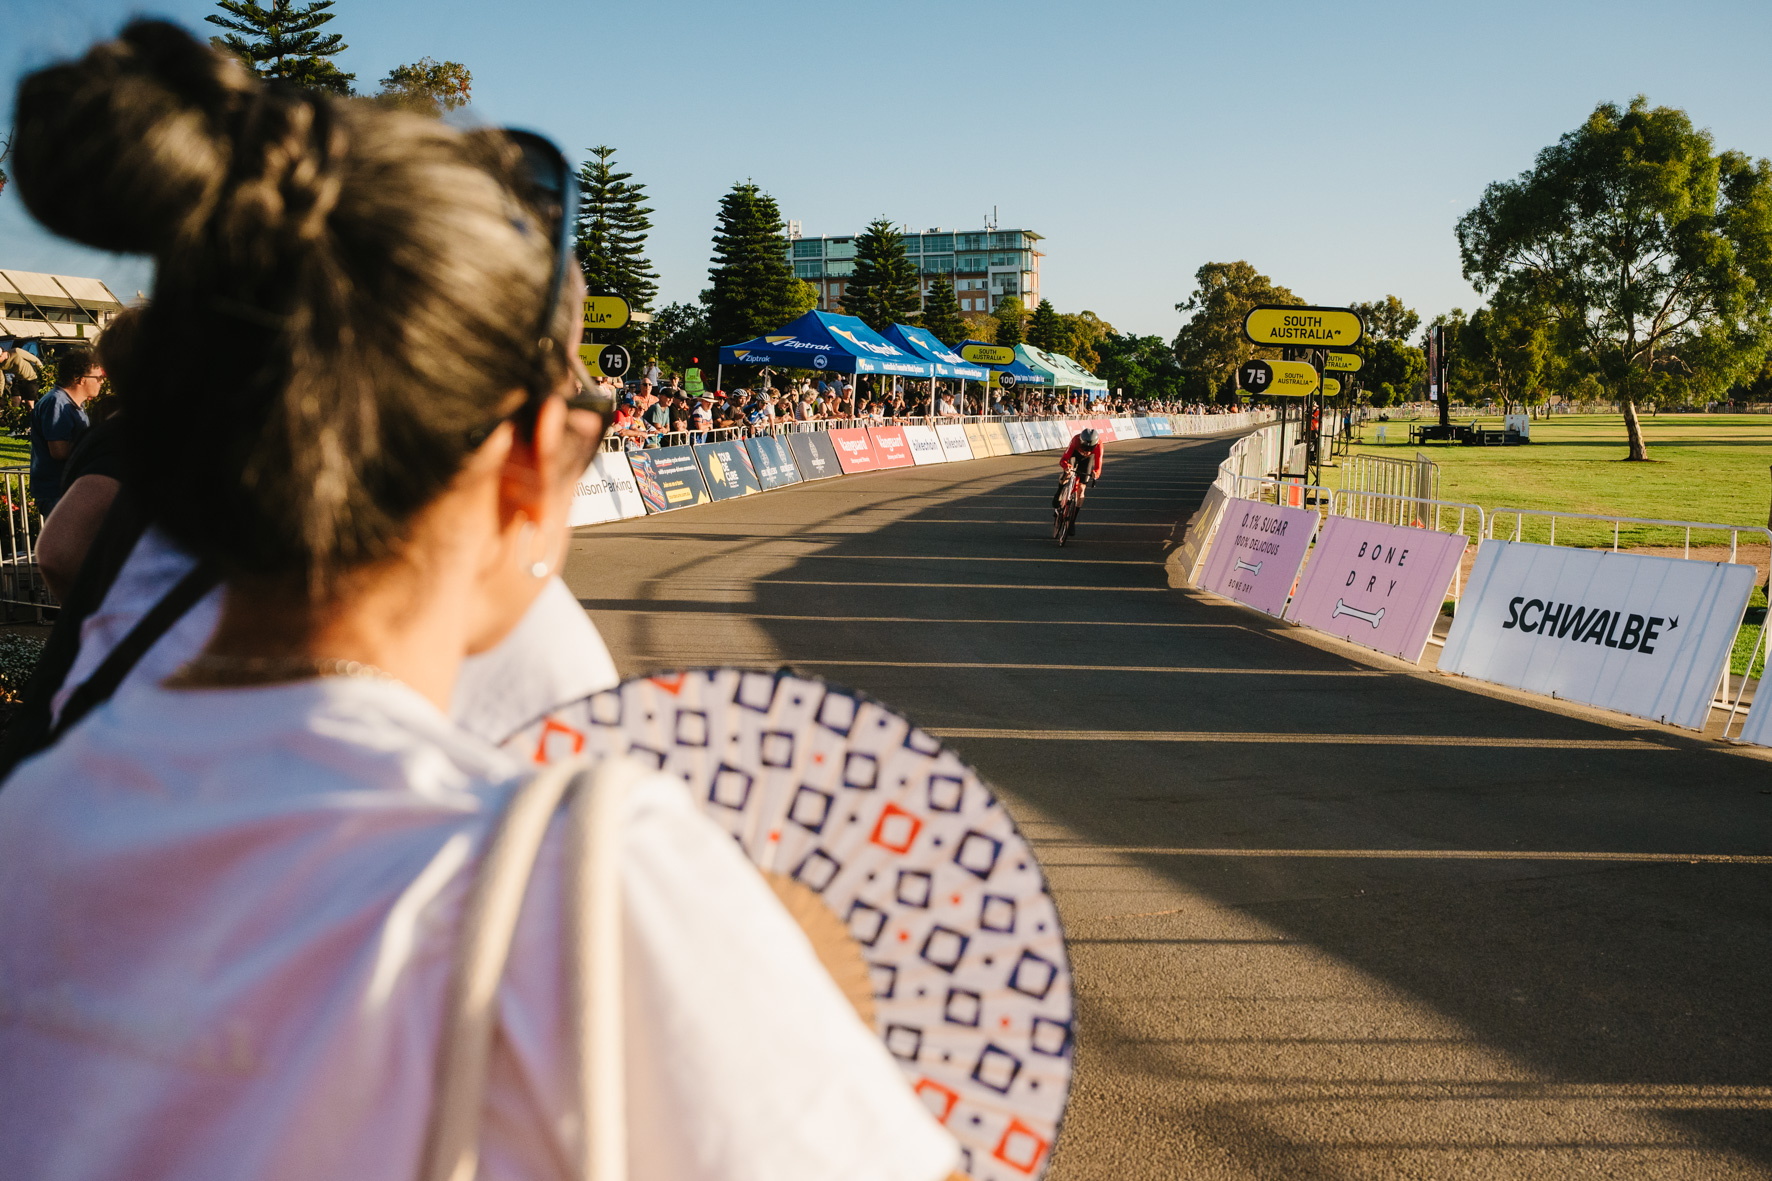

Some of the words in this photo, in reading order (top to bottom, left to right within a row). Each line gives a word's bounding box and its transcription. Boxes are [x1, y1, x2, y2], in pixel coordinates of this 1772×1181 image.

[1283, 315, 1322, 327] SOUTH
[1270, 327, 1334, 340] AUSTRALIA
[784, 340, 832, 351] Ziptrak
[606, 354, 622, 368] 75
[745, 354, 770, 363] Ziptrak
[1000, 376, 1014, 385] 100
[1247, 368, 1266, 384] 75
[1277, 378, 1309, 386] AUSTRALIA
[1284, 372, 1304, 380] SOUTH
[717, 451, 732, 462] TOUR
[725, 470, 739, 481] CURE
[601, 478, 634, 493] Parking
[1241, 512, 1262, 530] 0.1%
[1260, 516, 1289, 537] SUGAR
[1234, 534, 1251, 548] 100%
[1248, 538, 1280, 556] DELICIOUS
[1358, 541, 1409, 567] BONE
[1228, 578, 1243, 591] BONE
[1242, 583, 1253, 594] DRY
[1346, 570, 1398, 598] DRY
[1502, 596, 1665, 655] SCHWALBE
